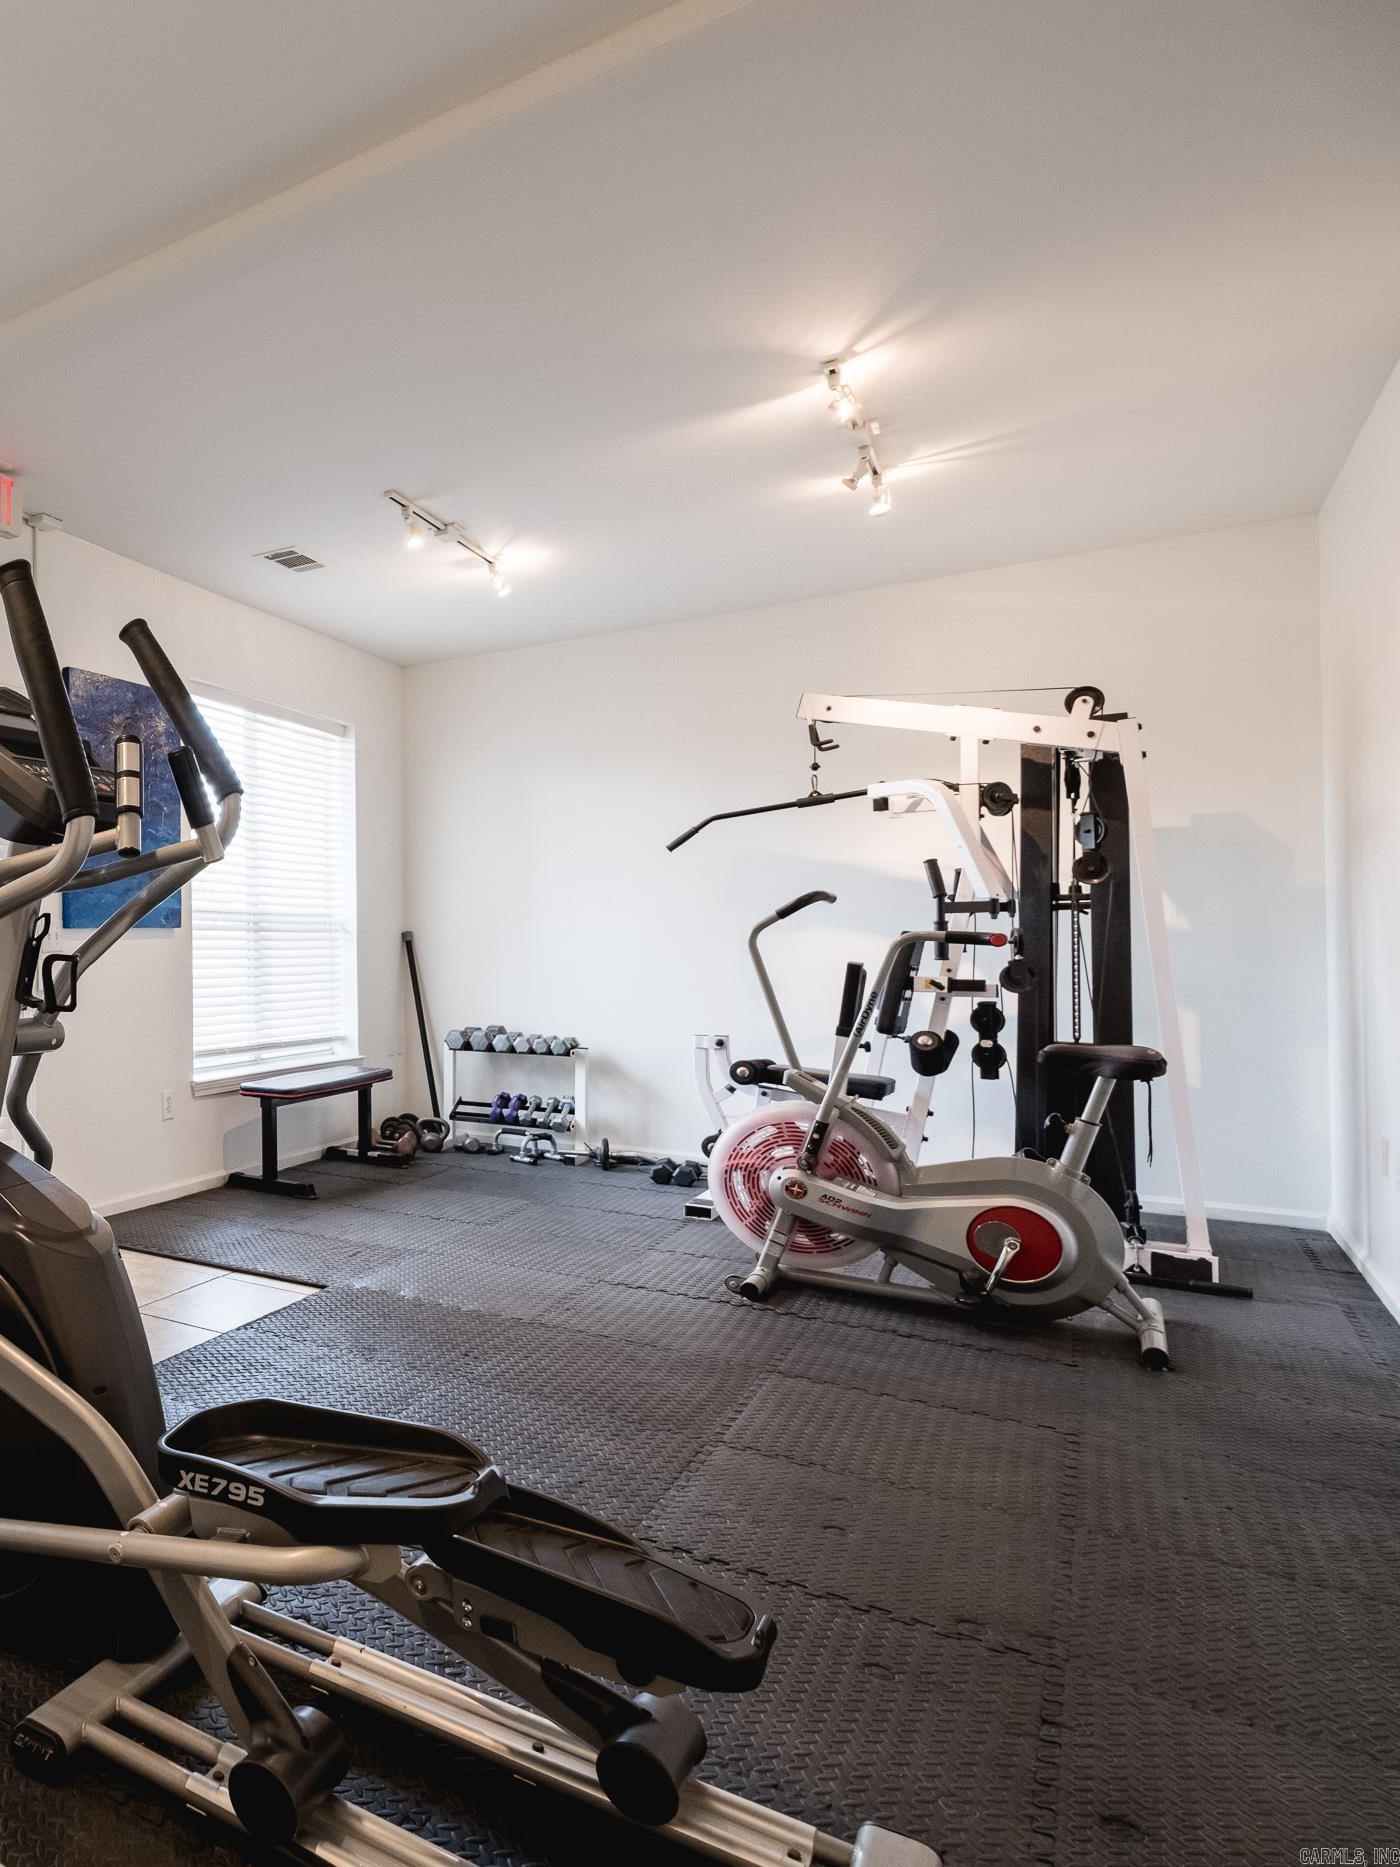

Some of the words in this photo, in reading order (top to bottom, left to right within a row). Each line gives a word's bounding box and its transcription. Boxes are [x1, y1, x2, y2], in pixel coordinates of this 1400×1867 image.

[817, 1196, 872, 1218] SCHWINN
[820, 1193, 843, 1203] AD2
[177, 1469, 266, 1507] XE795
